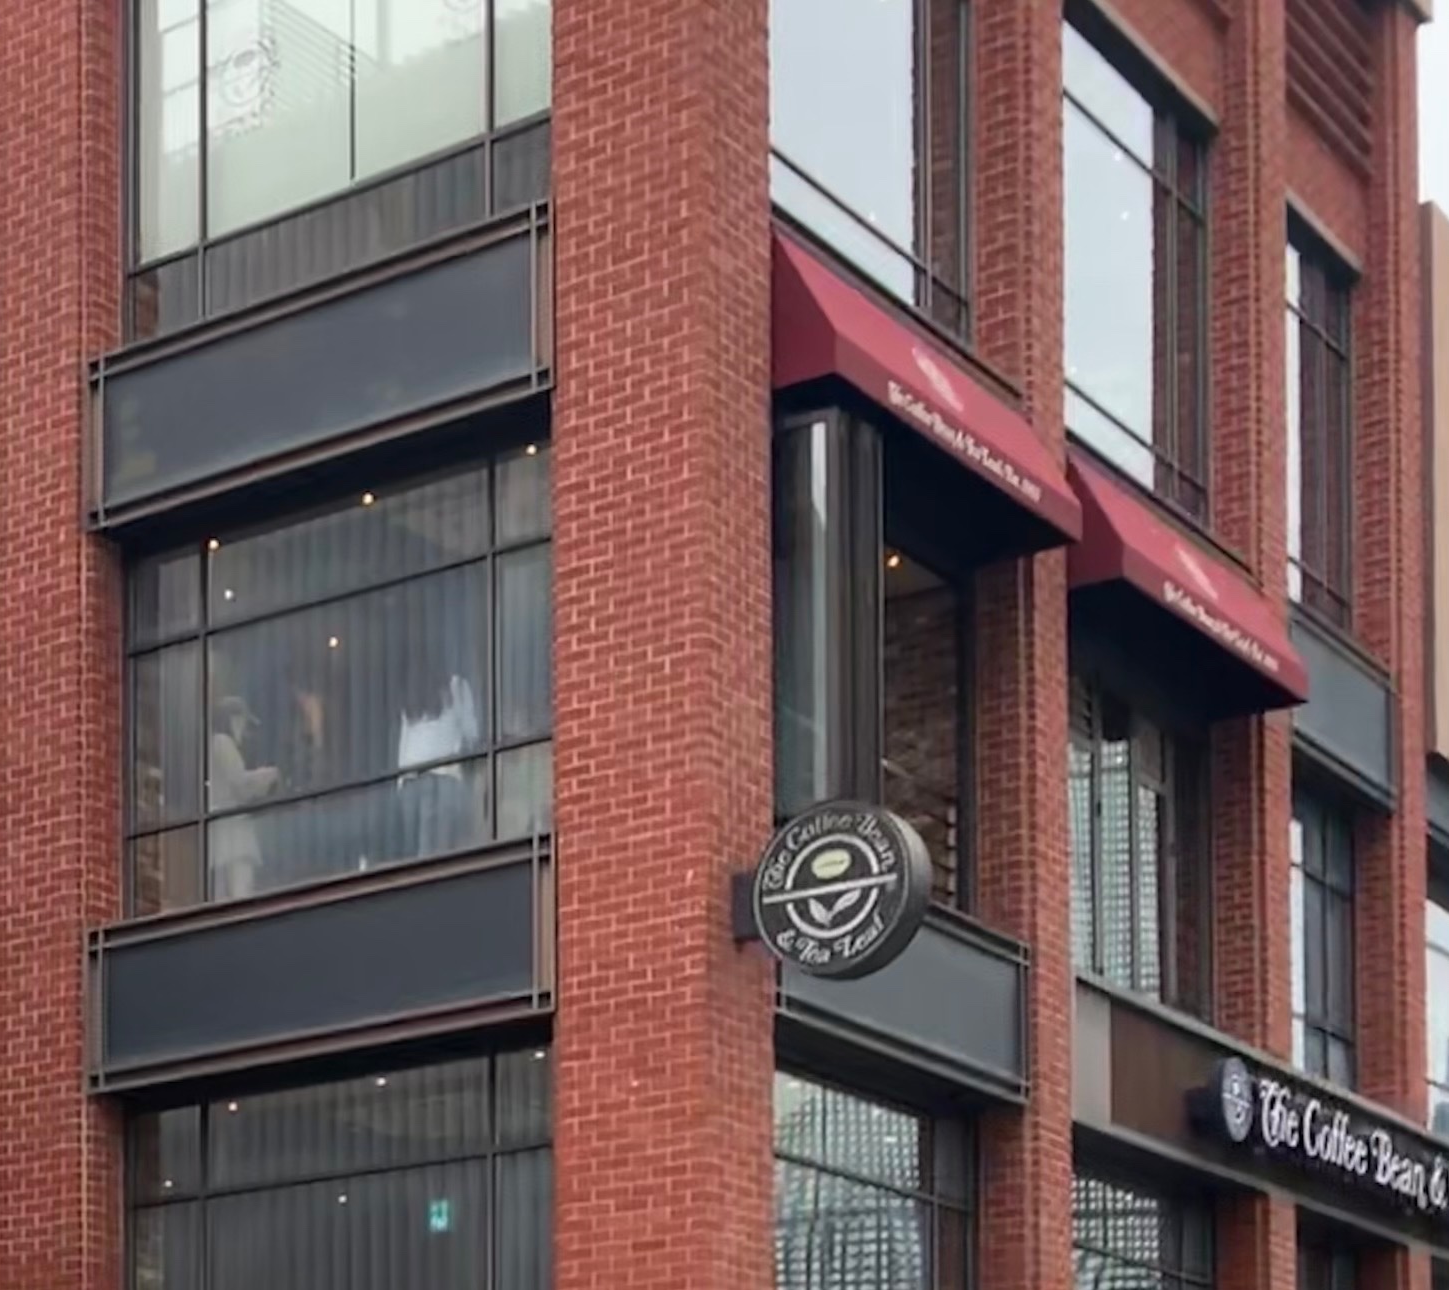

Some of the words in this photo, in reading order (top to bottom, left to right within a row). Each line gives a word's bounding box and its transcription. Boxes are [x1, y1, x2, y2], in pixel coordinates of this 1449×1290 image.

[797, 937, 832, 964] Tea
[833, 908, 885, 957] Leaf
[1259, 1078, 1300, 1148] The
[1303, 1099, 1369, 1175] Coffee
[1370, 1127, 1428, 1210] Bean
